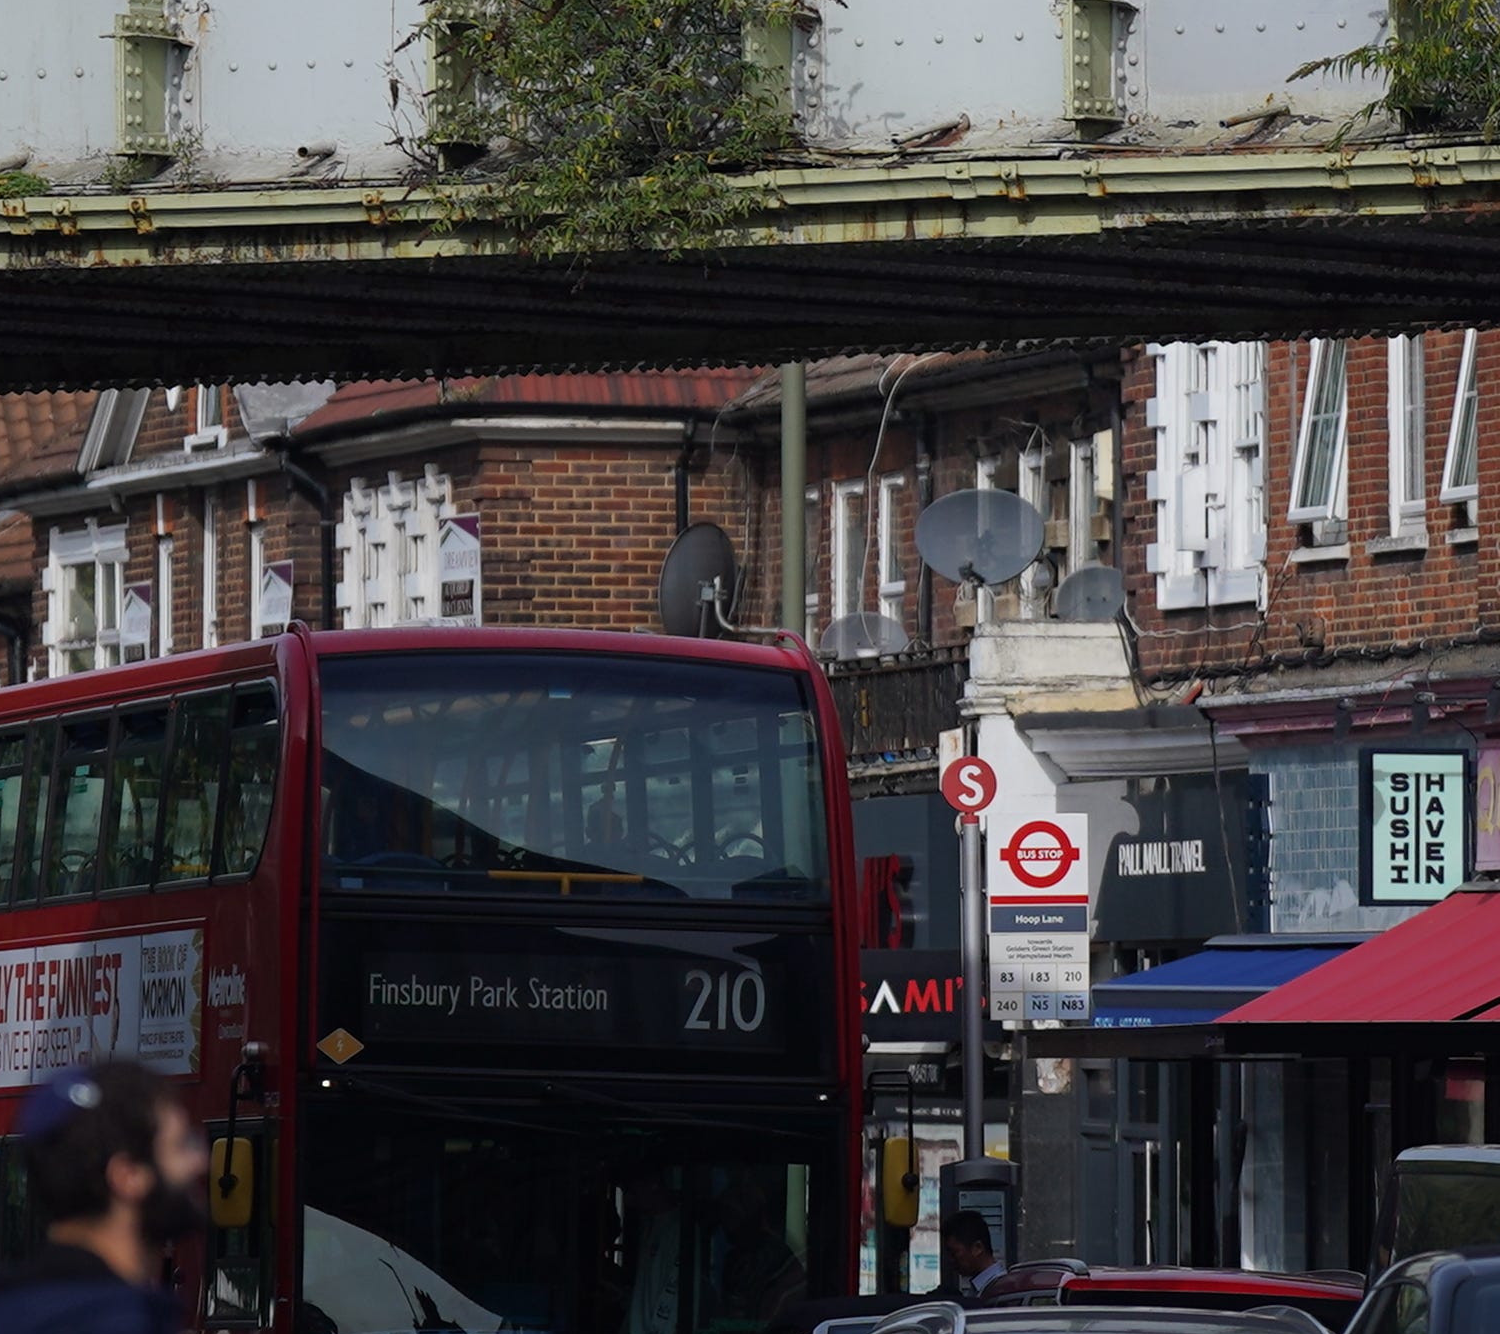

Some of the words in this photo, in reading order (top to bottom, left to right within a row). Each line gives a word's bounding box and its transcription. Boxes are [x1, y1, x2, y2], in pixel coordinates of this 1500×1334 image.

[957, 764, 985, 807] S
[1390, 772, 1410, 884] SUSHI
[1425, 773, 1445, 885] HAVEN
[1016, 849, 1037, 860] BUS
[1038, 849, 1064, 860] STOP
[1118, 843, 1143, 877] PALL
[1143, 841, 1169, 875] MALL
[1170, 839, 1206, 874] TRAVEL
[1015, 915, 1043, 926] Hoop
[1043, 915, 1064, 924] Lane
[15, 959, 46, 1022] THE
[47, 953, 122, 1021] FUNNIEST
[141, 976, 186, 1020] MORMON
[367, 973, 461, 1016] Finsbury
[469, 976, 520, 1009] Park
[527, 977, 609, 1012] Station
[1000, 972, 1015, 983] 83
[1030, 972, 1051, 983] 183
[1064, 971, 1083, 982] 210
[683, 969, 767, 1033] 210
[996, 1000, 1018, 1011] 240
[1032, 999, 1049, 1011] N5
[1061, 999, 1085, 1011] N83
